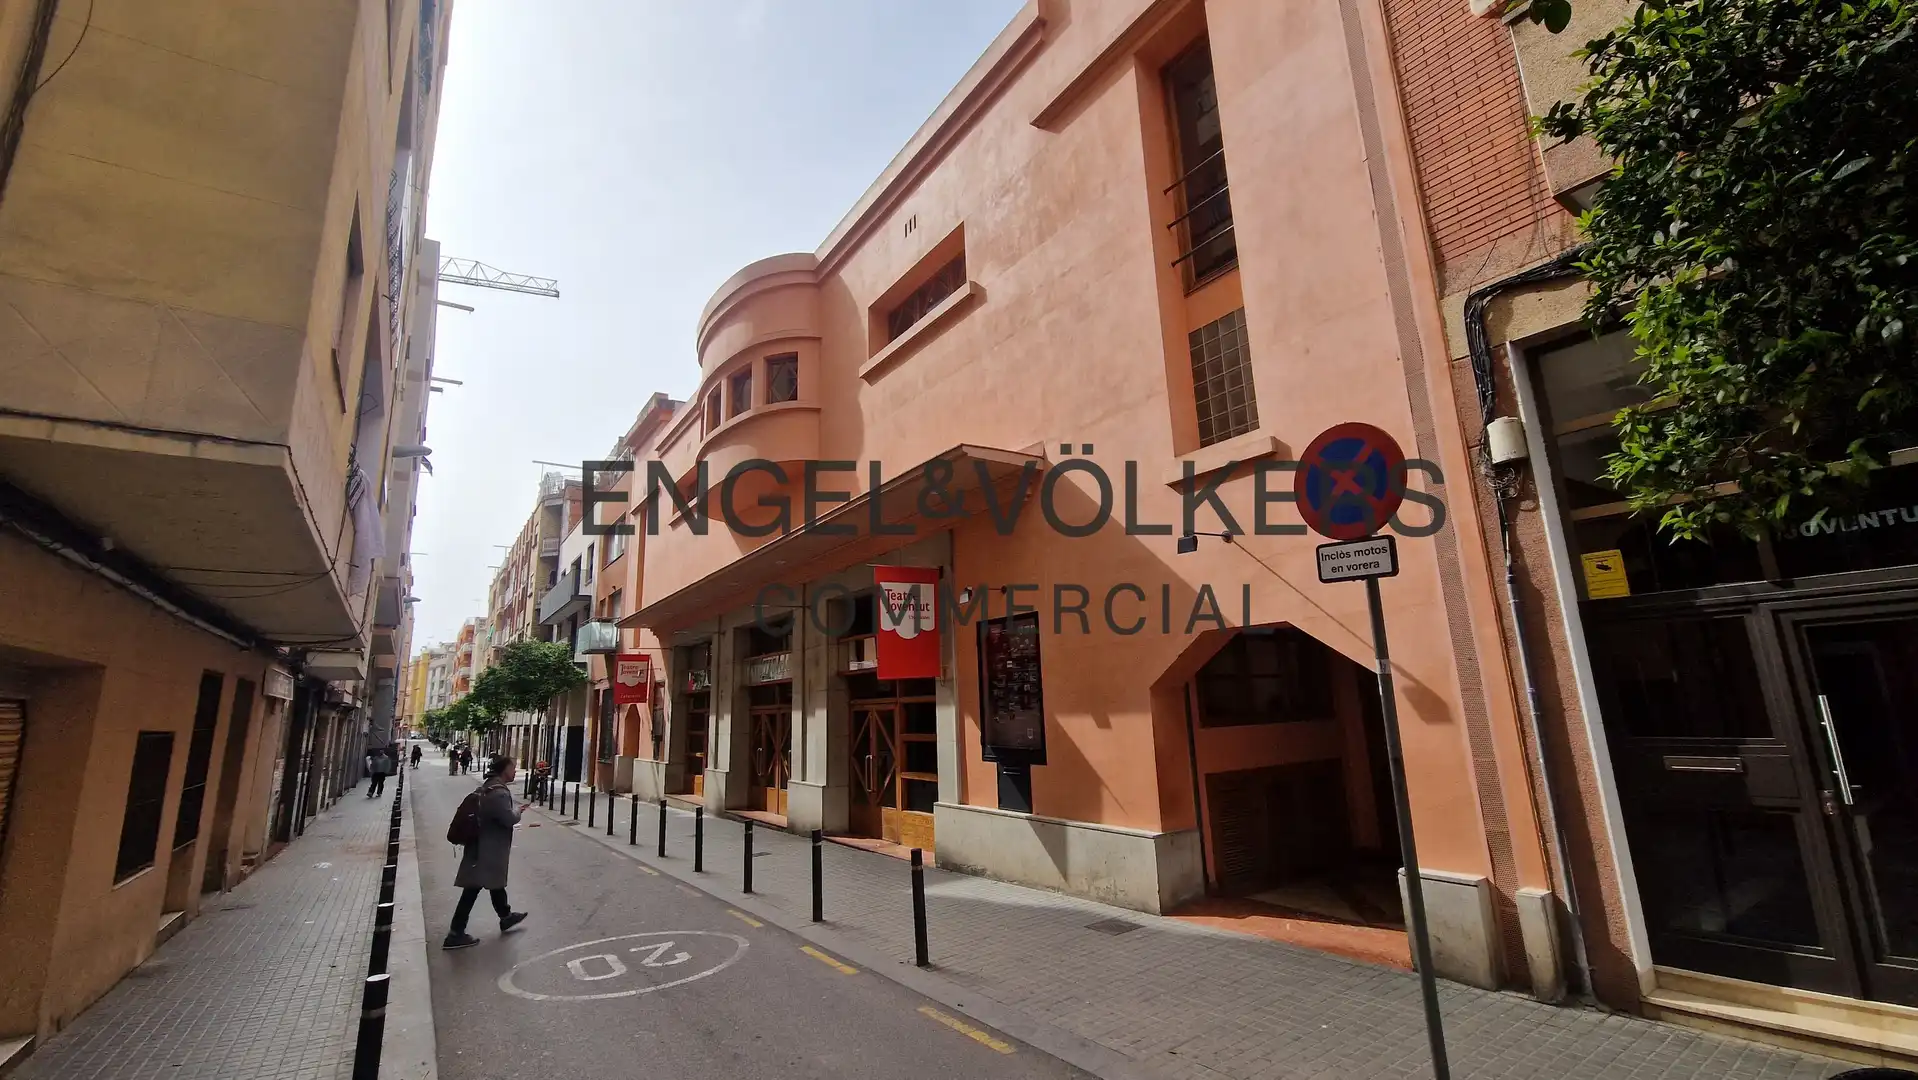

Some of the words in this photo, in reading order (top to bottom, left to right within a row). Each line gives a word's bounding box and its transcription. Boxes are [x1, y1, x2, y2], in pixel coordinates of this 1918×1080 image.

[1321, 550, 1351, 562] Inclòs
[1354, 546, 1388, 557] motos
[1331, 564, 1344, 574] en
[1346, 561, 1380, 572] vorera
[566, 940, 693, 981] 20
